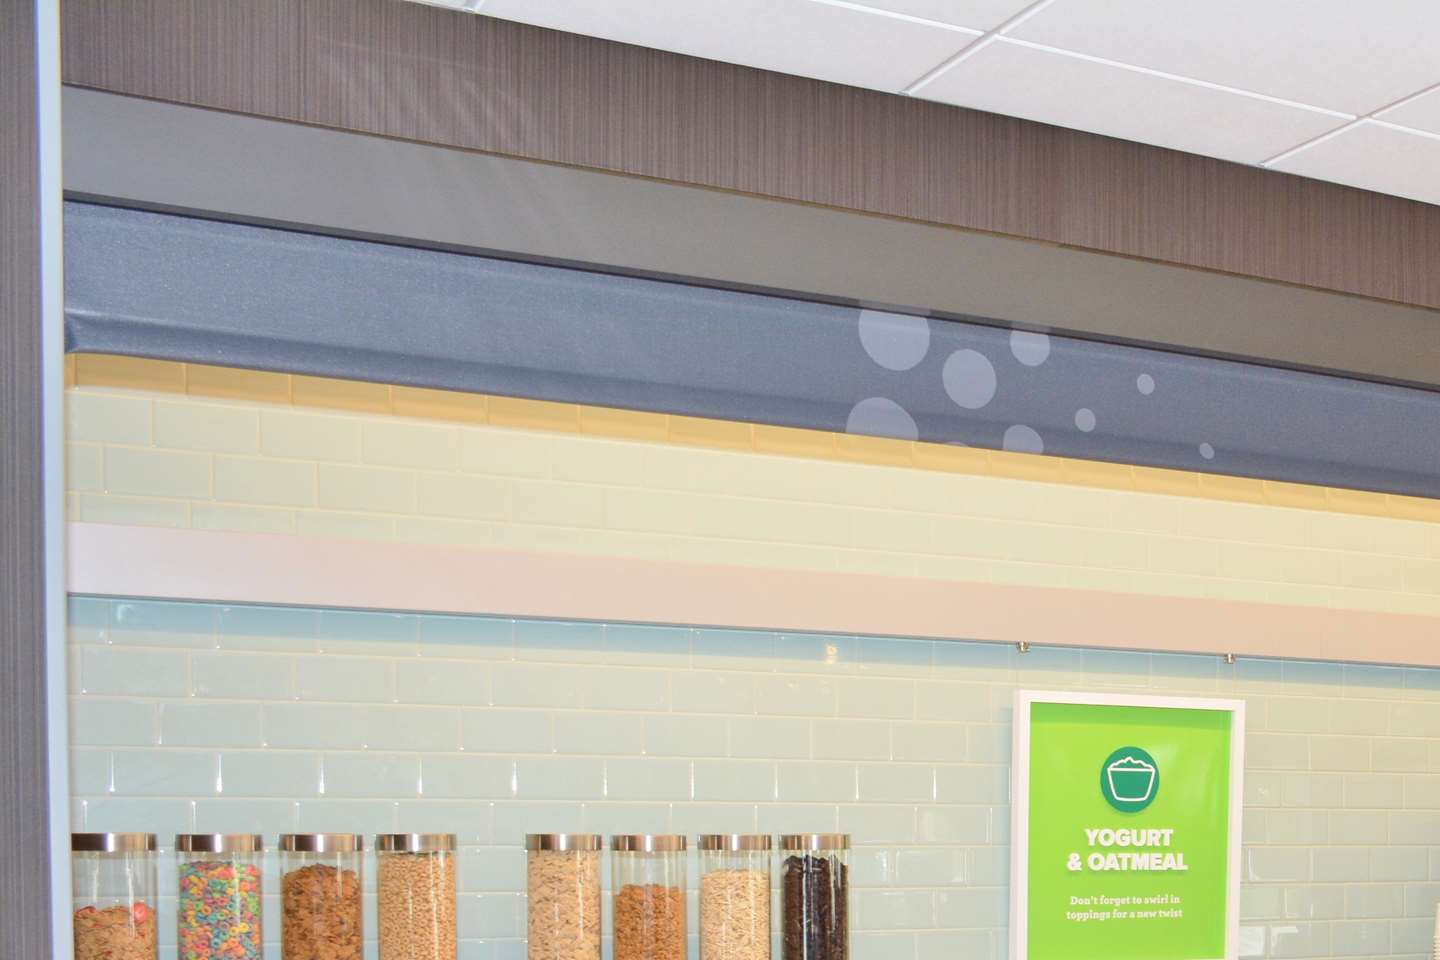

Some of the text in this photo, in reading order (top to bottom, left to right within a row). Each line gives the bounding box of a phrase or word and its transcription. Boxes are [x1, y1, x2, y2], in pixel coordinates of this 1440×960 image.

[1084, 828, 1174, 847] YOGURT
[1067, 851, 1188, 871] & OATMEAL
[1070, 895, 1181, 907] Don't forget to swirl in
[1066, 909, 1111, 920] toppings
[1112, 909, 1127, 918] for
[1158, 909, 1182, 918] twist
